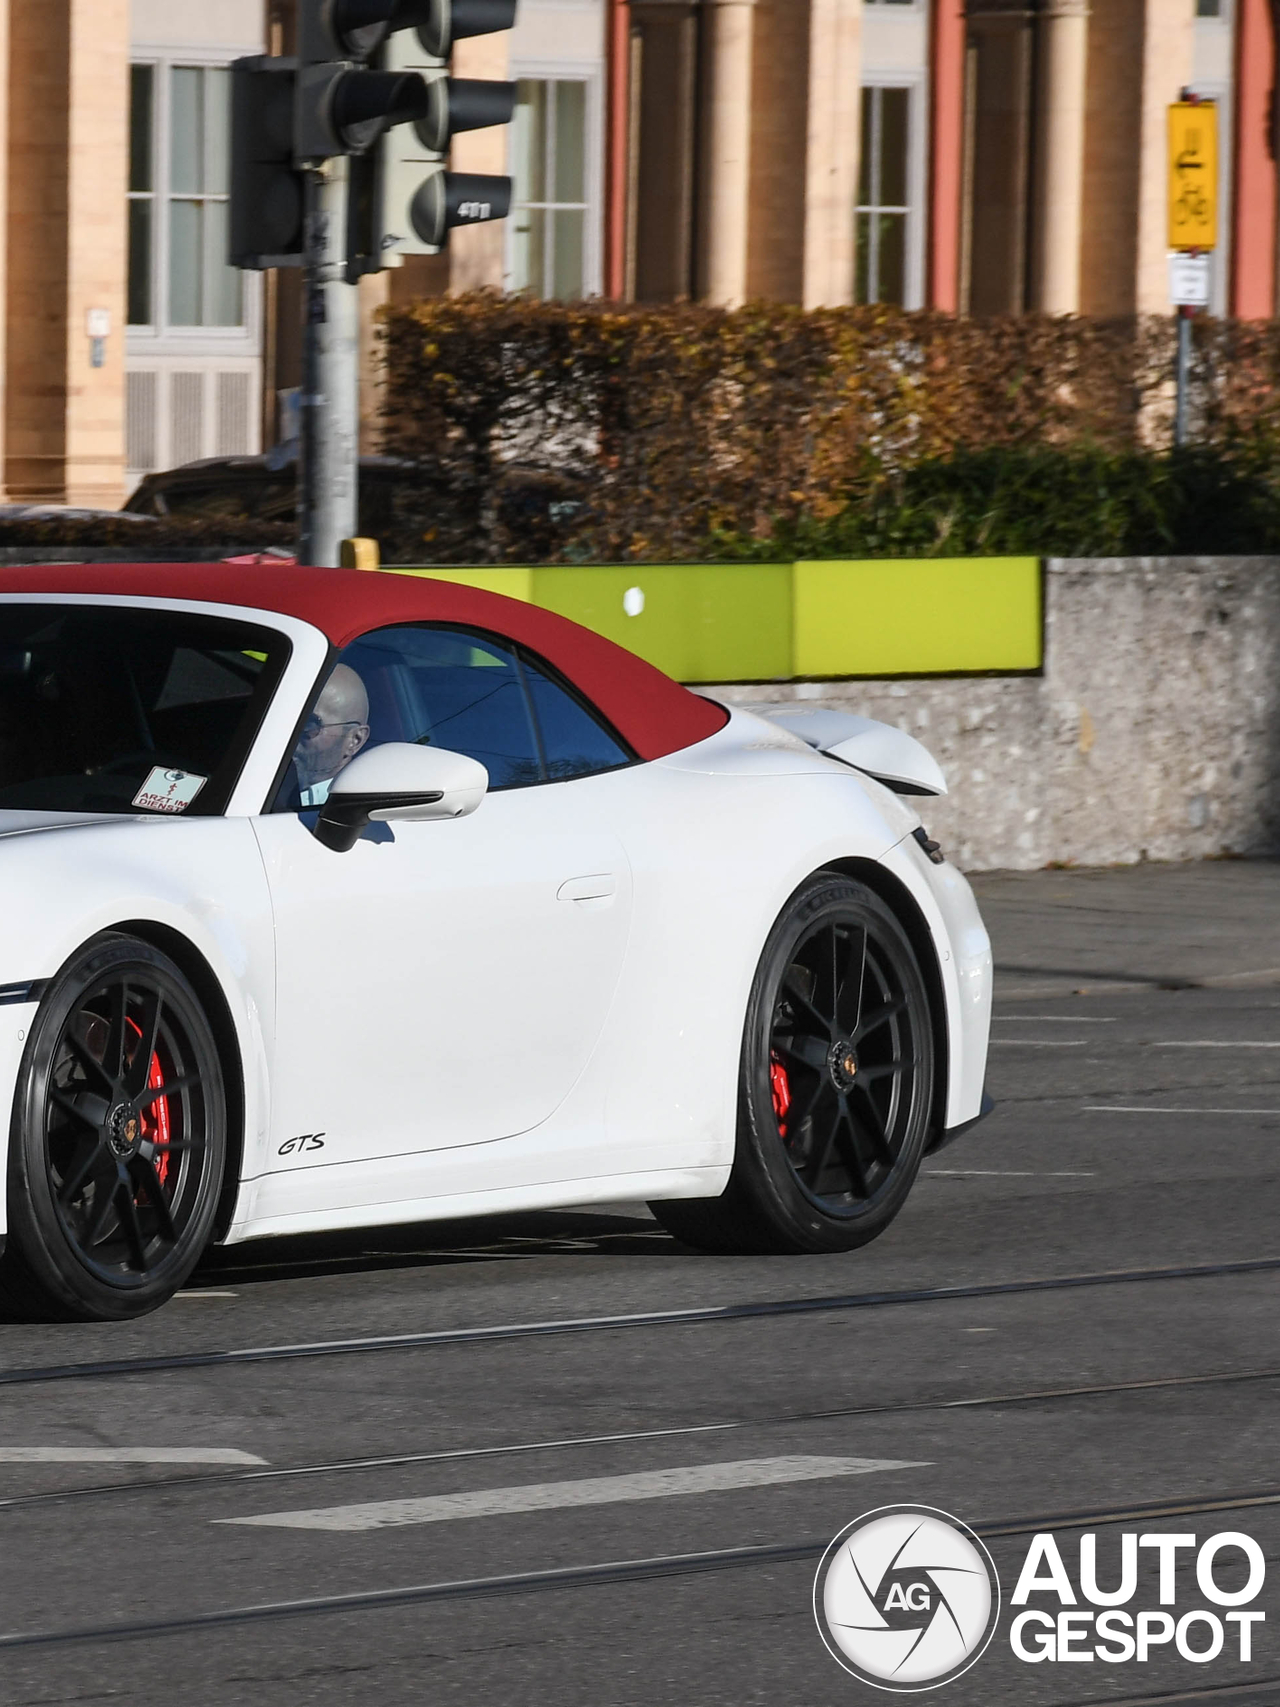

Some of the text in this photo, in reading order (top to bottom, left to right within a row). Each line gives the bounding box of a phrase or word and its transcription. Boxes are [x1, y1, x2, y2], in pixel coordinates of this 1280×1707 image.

[138, 798, 183, 812] DIENST
[140, 792, 189, 808] ARZT IM
[278, 1132, 326, 1156] GTS
